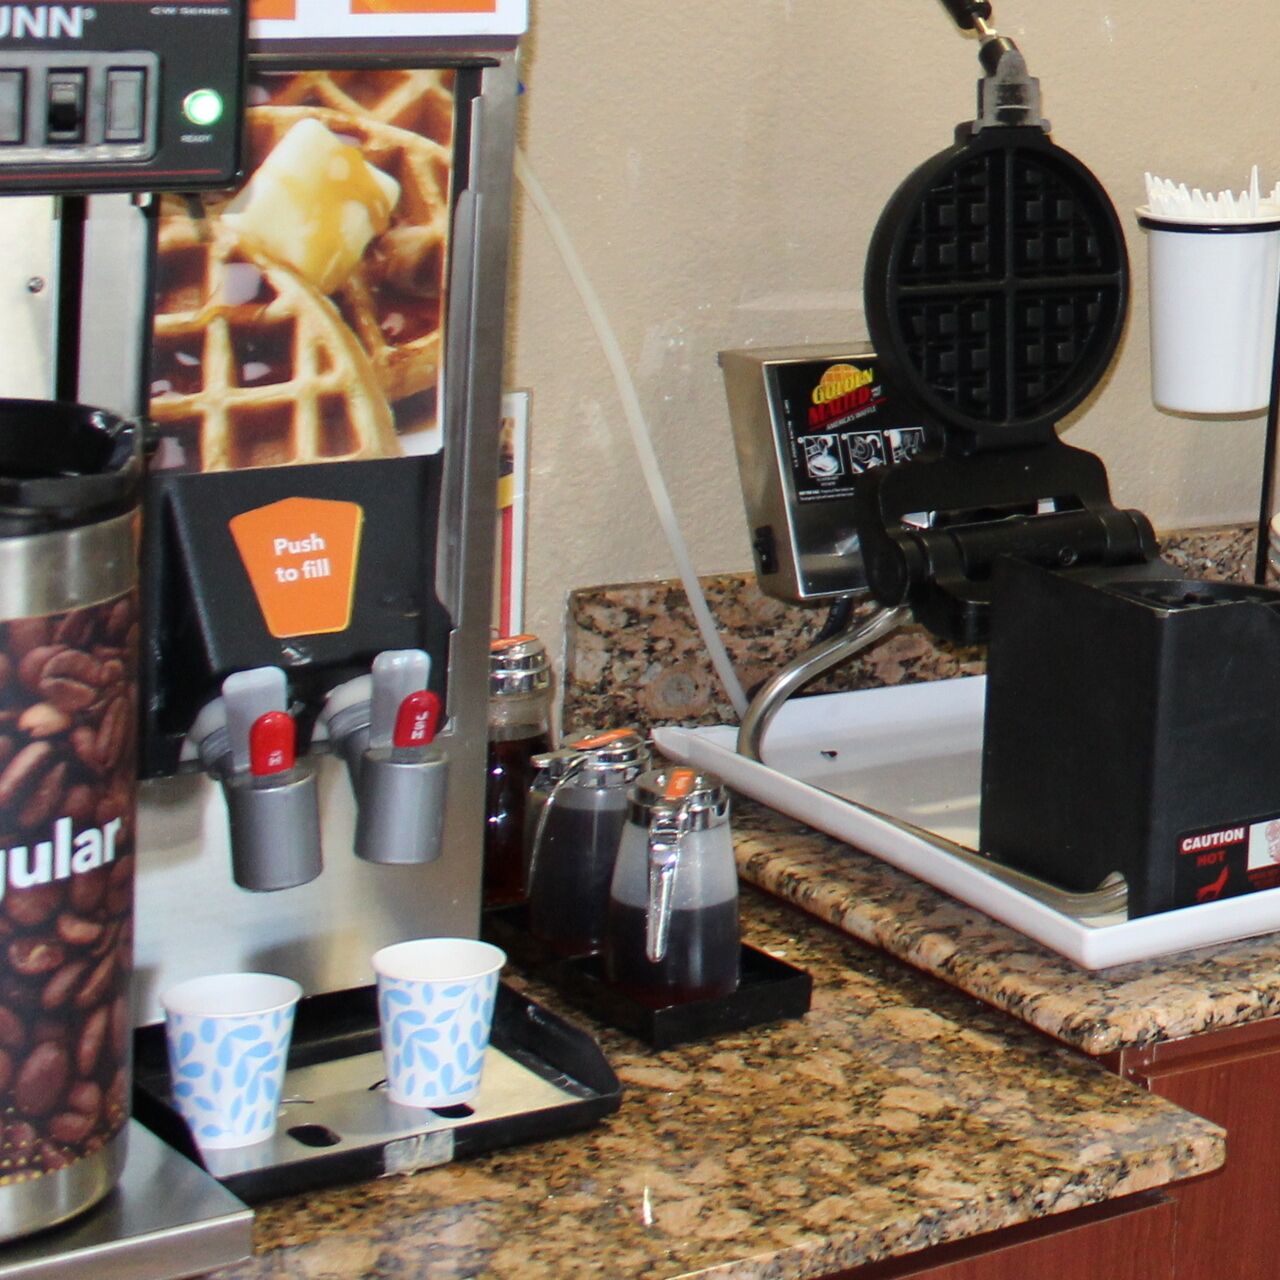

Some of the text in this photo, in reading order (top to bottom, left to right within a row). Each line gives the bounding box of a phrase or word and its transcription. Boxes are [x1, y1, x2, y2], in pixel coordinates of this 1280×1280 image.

[273, 532, 326, 556] Push
[274, 558, 331, 583] to fill
[1182, 827, 1245, 852] CAUTION
[1195, 850, 1227, 866] HOT
